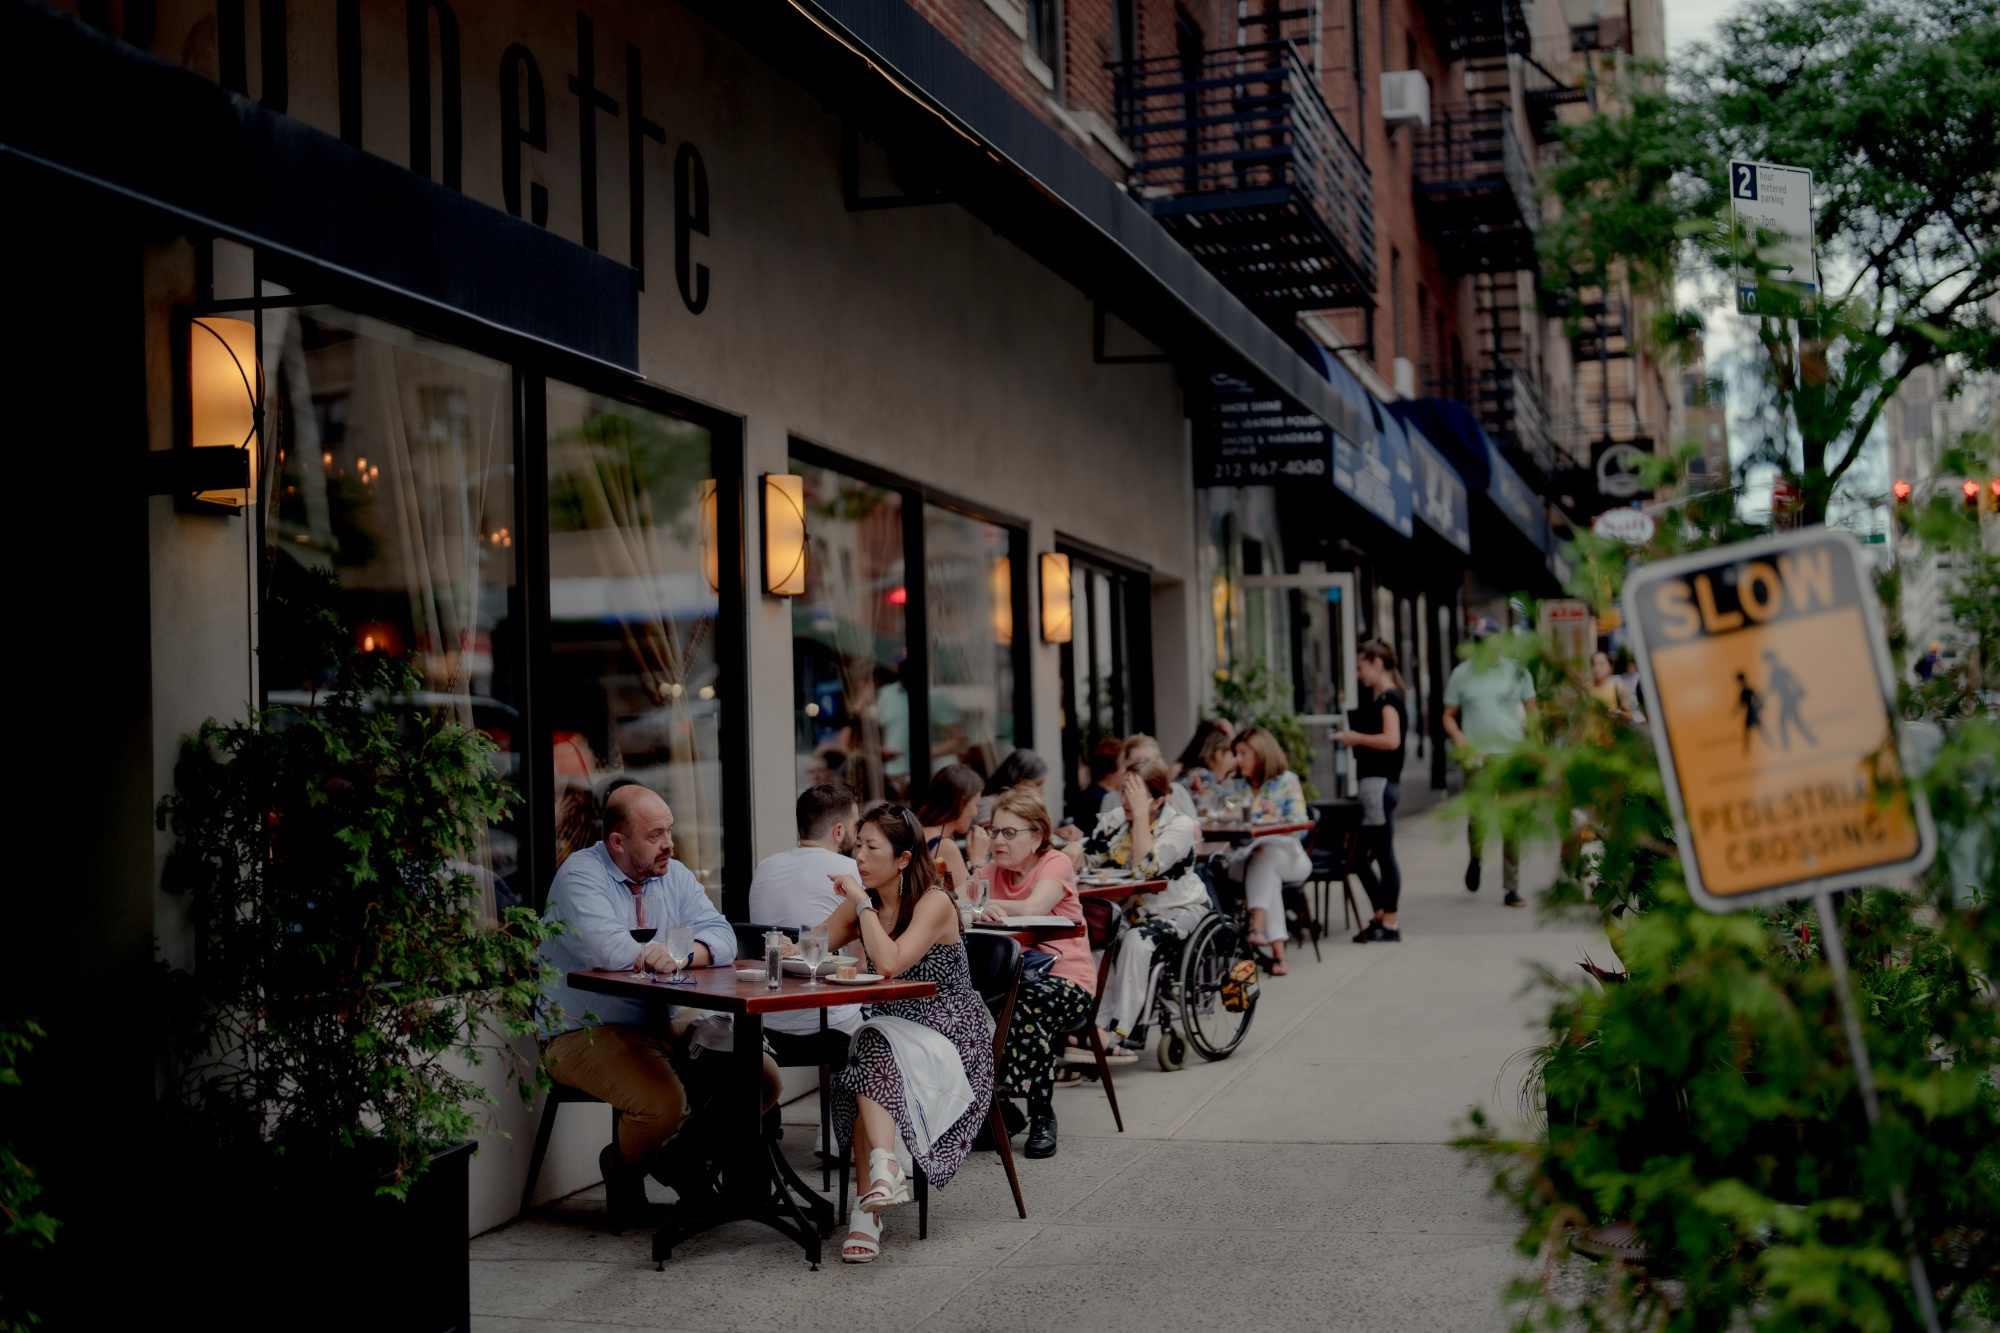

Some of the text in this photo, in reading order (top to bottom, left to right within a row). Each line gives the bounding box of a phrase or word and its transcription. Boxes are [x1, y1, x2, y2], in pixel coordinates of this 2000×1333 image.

[1737, 166, 1774, 198] 2 hour
[1760, 183, 1787, 194] metered
[1760, 195, 1784, 207] parking
[1737, 212, 1754, 224] 9am
[1760, 214, 1776, 228] 7pm
[1214, 458, 1325, 479] 212-967-4040
[1654, 548, 1833, 641] SLOW
[1725, 816, 1887, 874] CROSSING
